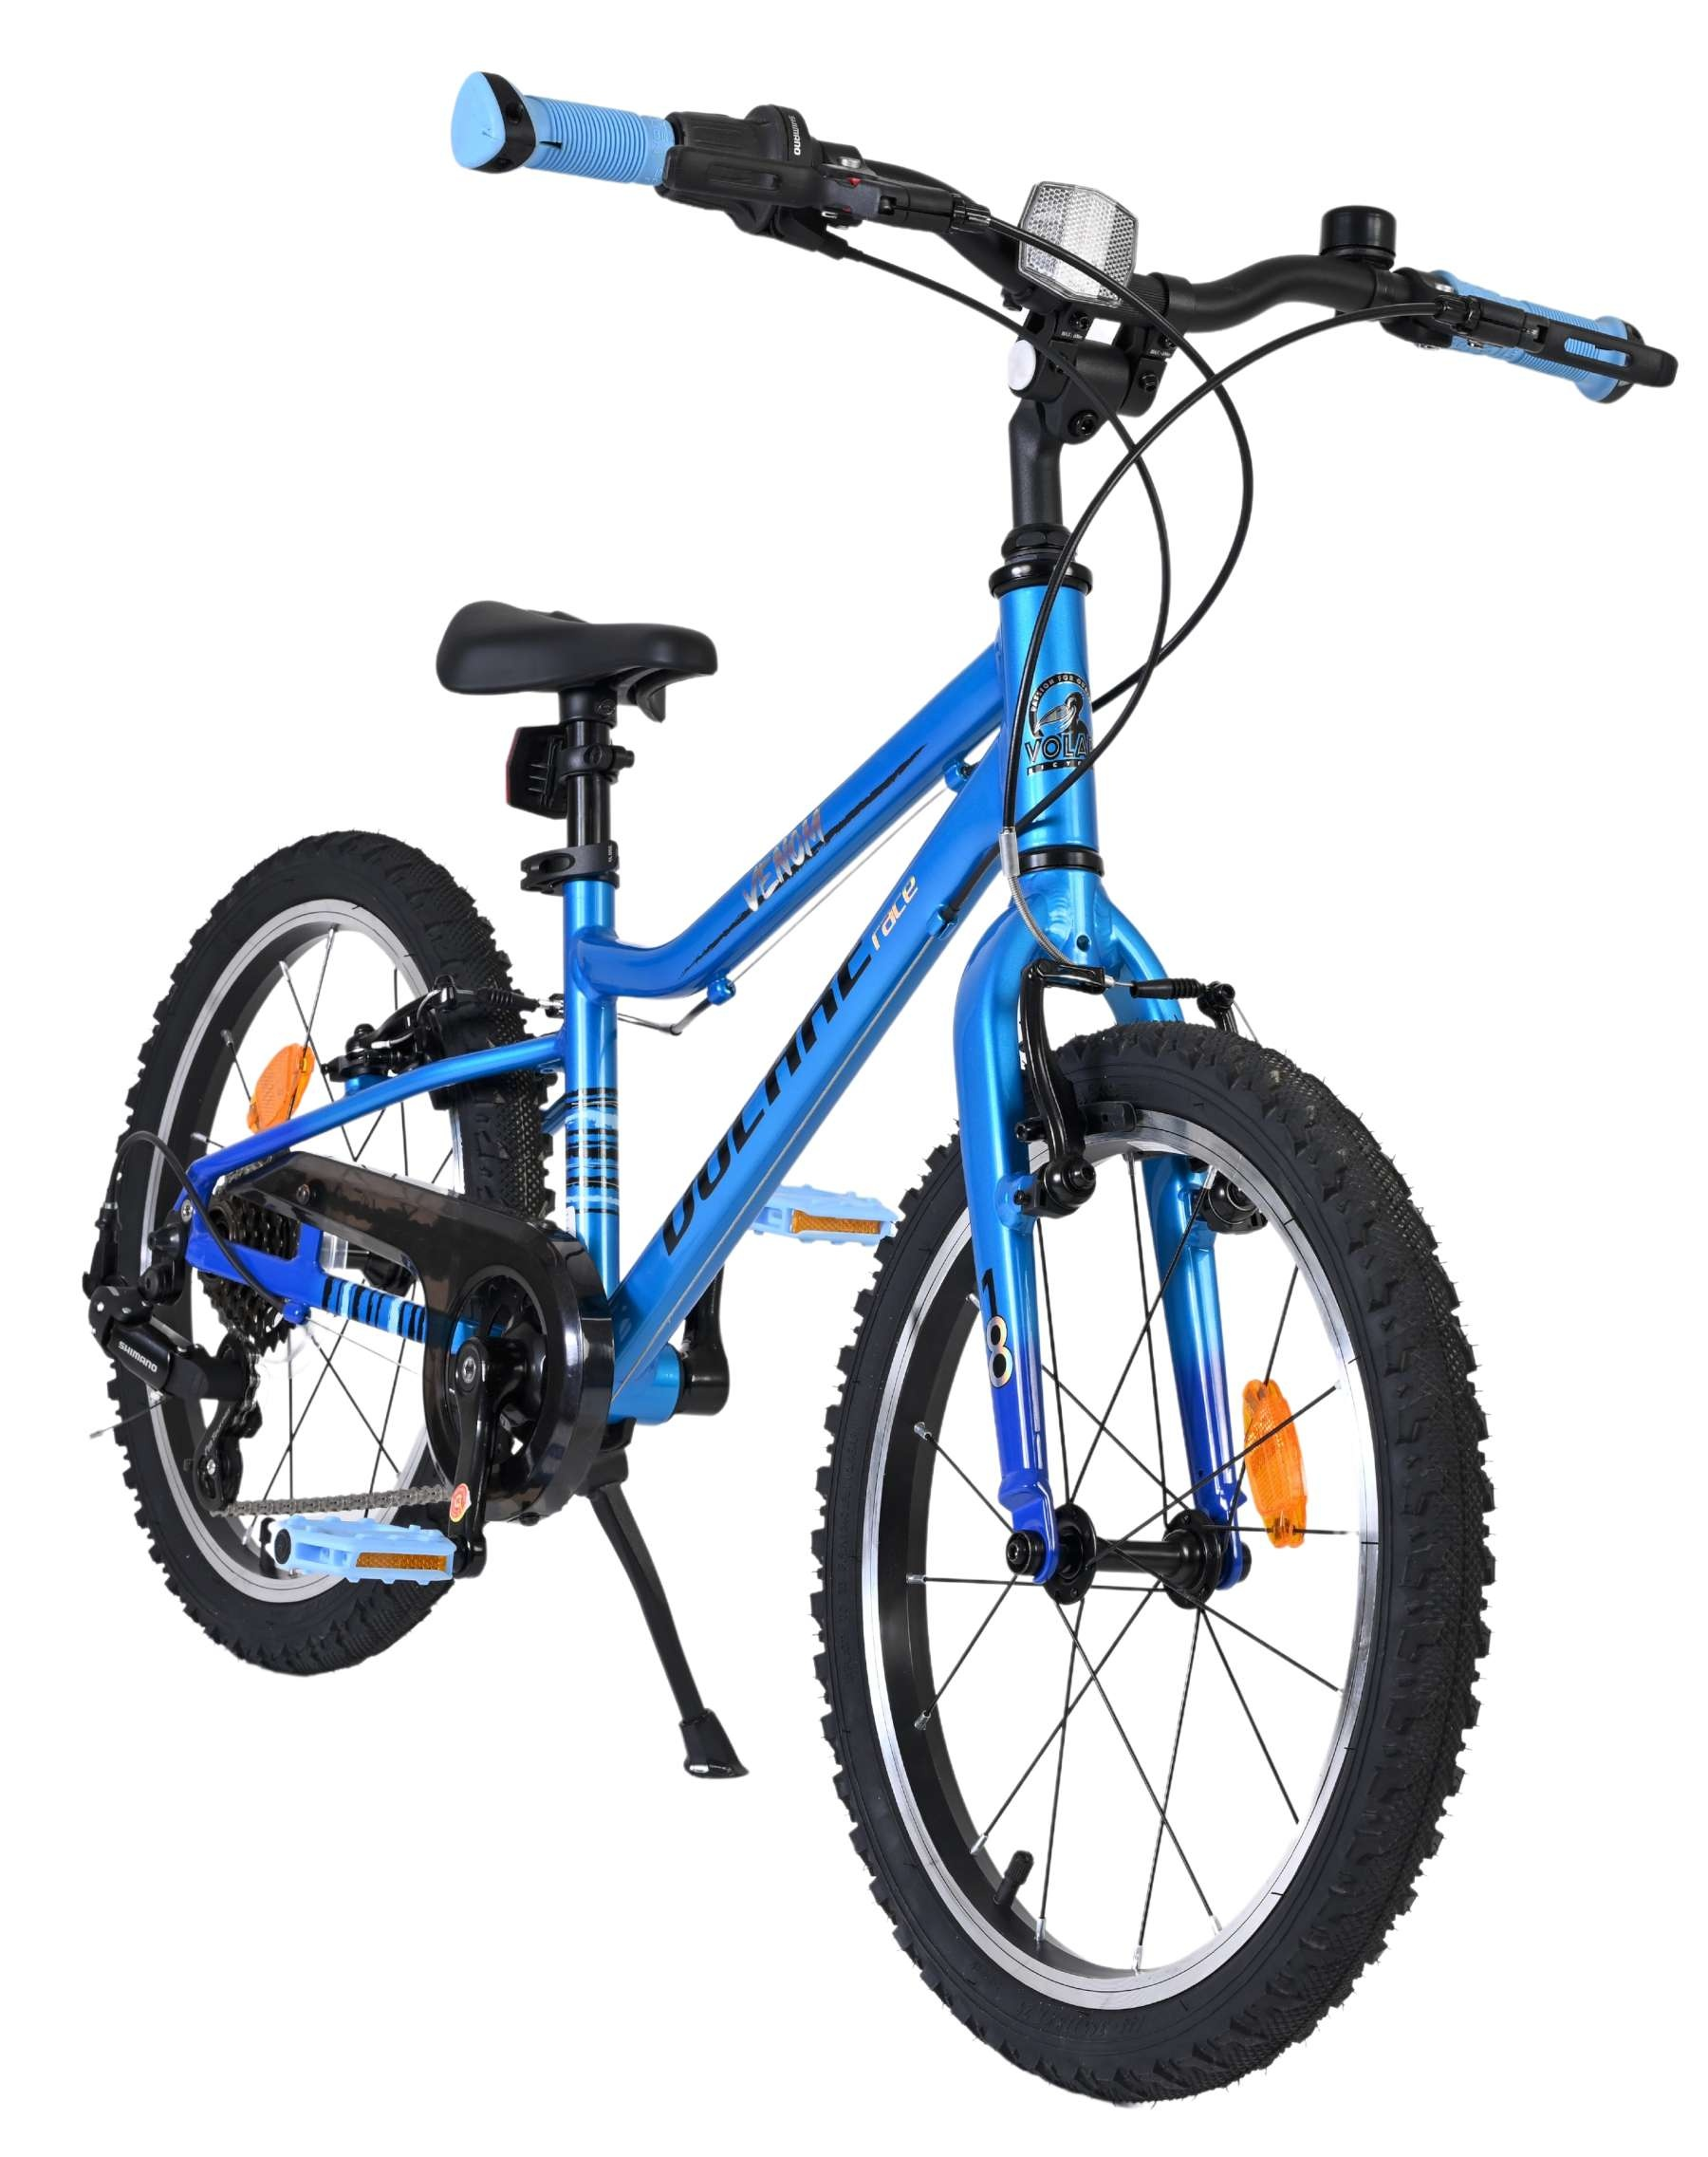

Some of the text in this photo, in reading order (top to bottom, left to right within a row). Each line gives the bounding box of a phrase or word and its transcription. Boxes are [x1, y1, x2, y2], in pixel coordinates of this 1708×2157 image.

[788, 115, 801, 156] SHIMANO
[743, 808, 825, 911] VENOM
[118, 1341, 158, 1372] SHIMANO
[982, 1268, 1013, 1388] 18
